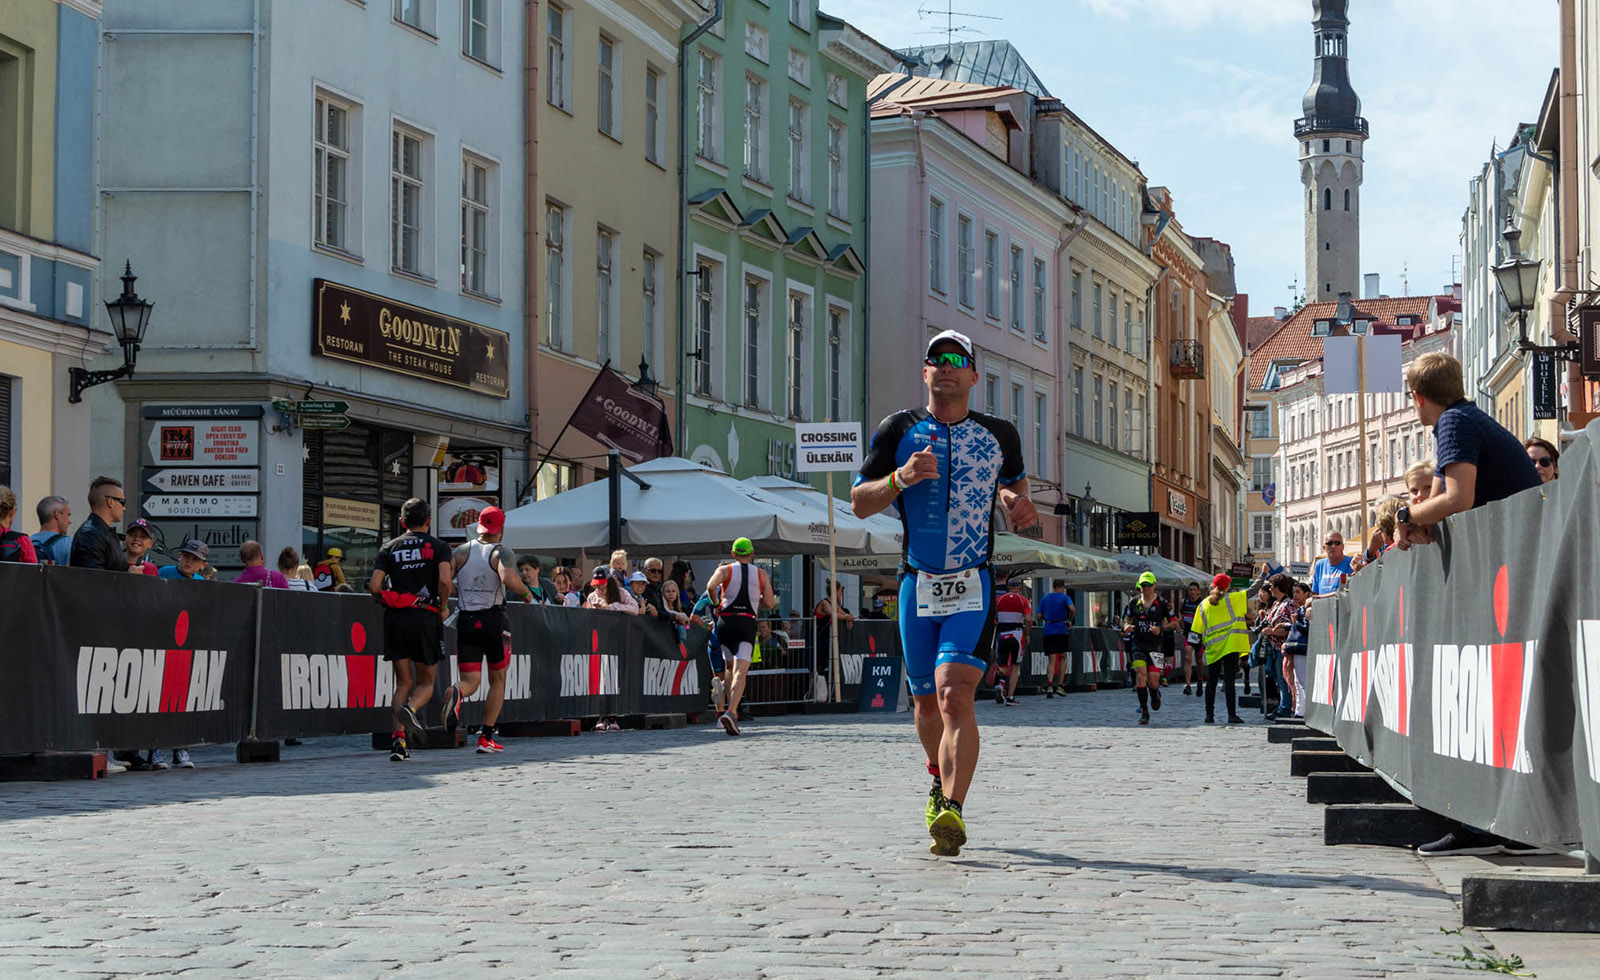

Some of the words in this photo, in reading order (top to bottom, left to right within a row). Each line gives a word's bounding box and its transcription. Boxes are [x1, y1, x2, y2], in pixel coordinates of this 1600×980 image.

[379, 308, 462, 356] GOODWIN
[326, 335, 364, 354] RESTORAN
[388, 351, 402, 363] THE
[404, 355, 427, 369] STEAK
[429, 362, 452, 375] HOUSE
[475, 372, 505, 388] RESTORAN
[162, 407, 211, 416] MÜÜRIVAHE
[213, 407, 240, 416] TÄNAV
[603, 399, 659, 438] GOODWI
[801, 432, 857, 443] CROSSING
[806, 451, 854, 464] ÜLEKÄIK
[171, 475, 200, 487] RAVEN
[202, 475, 225, 487] CAFE
[392, 547, 434, 563] TEAM
[932, 581, 967, 597] 376
[560, 653, 620, 697] IRONMAN
[643, 656, 700, 696] IRONMAN
[872, 666, 892, 676] KM
[77, 646, 227, 714] IRONMAN
[281, 653, 397, 710] IRONMA
[876, 678, 885, 688] 4
